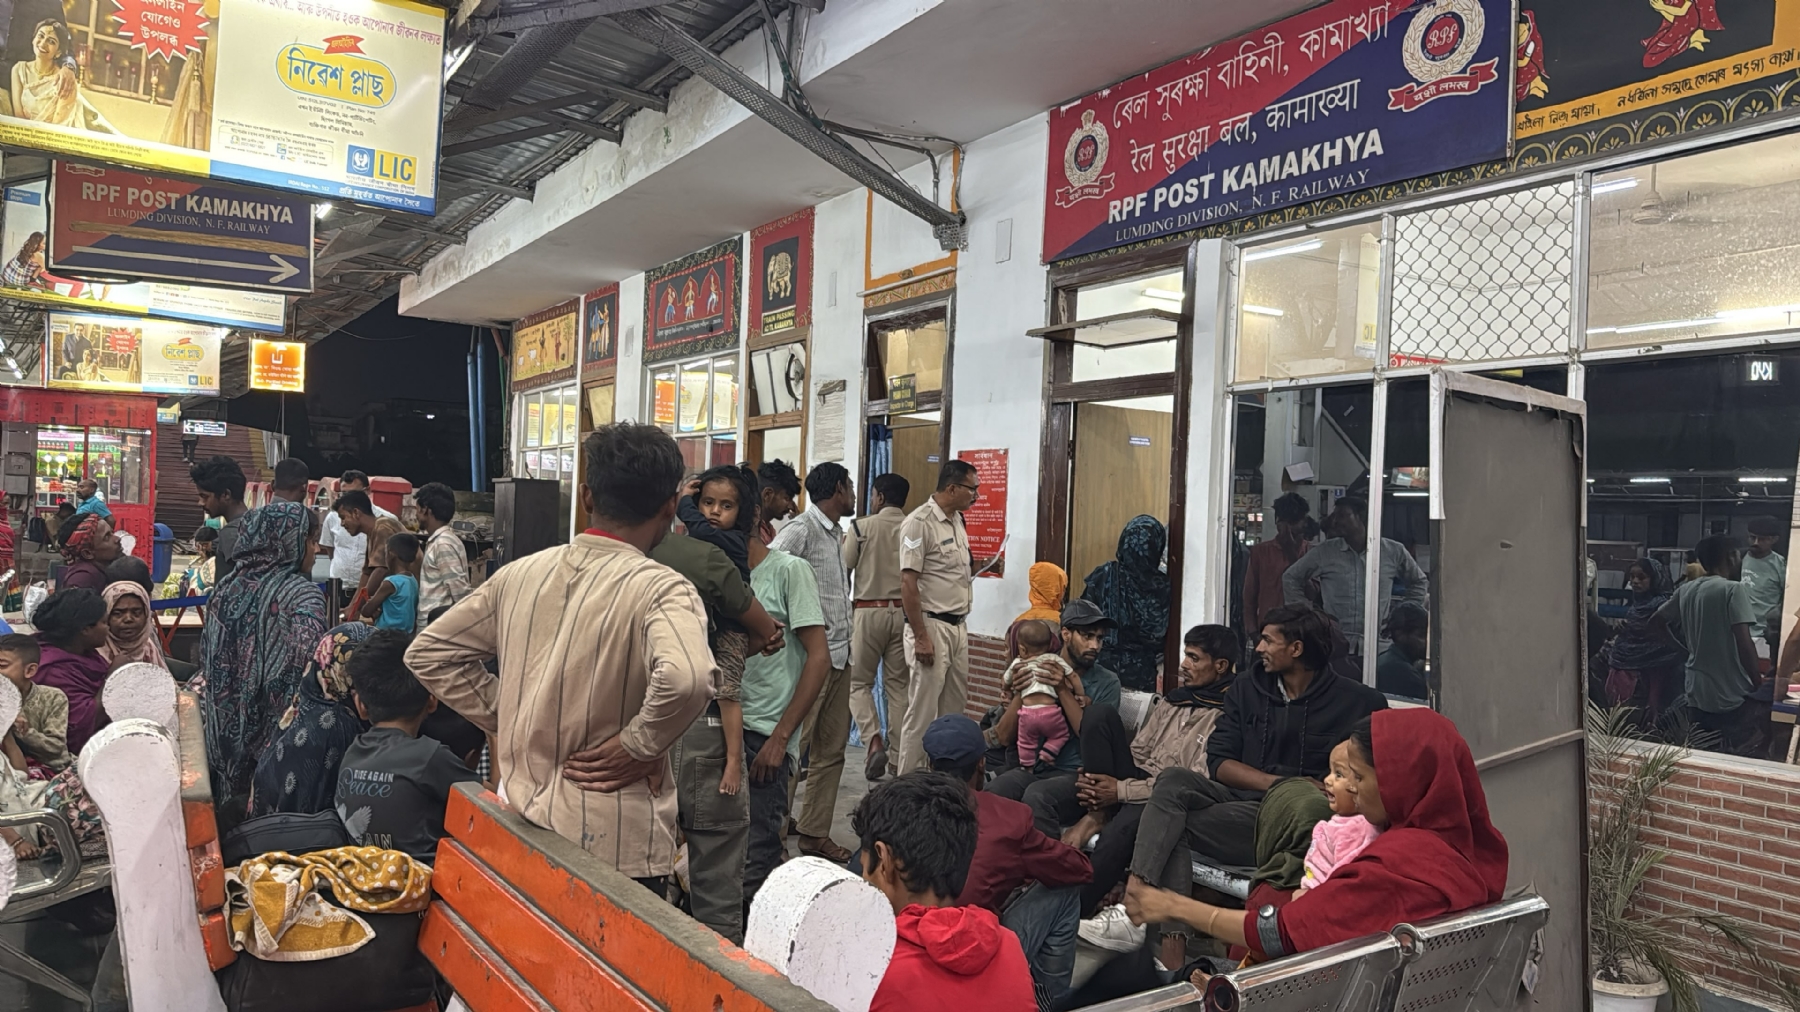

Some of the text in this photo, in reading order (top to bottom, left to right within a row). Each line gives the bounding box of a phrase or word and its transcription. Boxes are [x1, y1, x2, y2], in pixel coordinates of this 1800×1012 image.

[1113, 90, 1150, 129] ৰেল
[1217, 31, 1289, 91] বাহিনী,
[1298, 1, 1391, 62] কামাখ্যা
[1129, 78, 1361, 175] रेल सुरक्षा बल, कामाख्या
[378, 153, 413, 182] LIC
[1108, 127, 1385, 224] RPF POST KAMAKHYA
[82, 181, 294, 224] RPF POST KAMAKHYA
[1116, 169, 1371, 242] LUMDING DIVISION, N. F. RAILWAY
[107, 207, 271, 235] LUMDING DIVISION, N. F. RAILWAY
[763, 309, 796, 325] TRAIN PASSING
[199, 375, 213, 386] LIC
[980, 535, 1001, 543] NOTICE
[338, 767, 393, 799] Peace
[353, 769, 394, 783] RISE AGAIN
